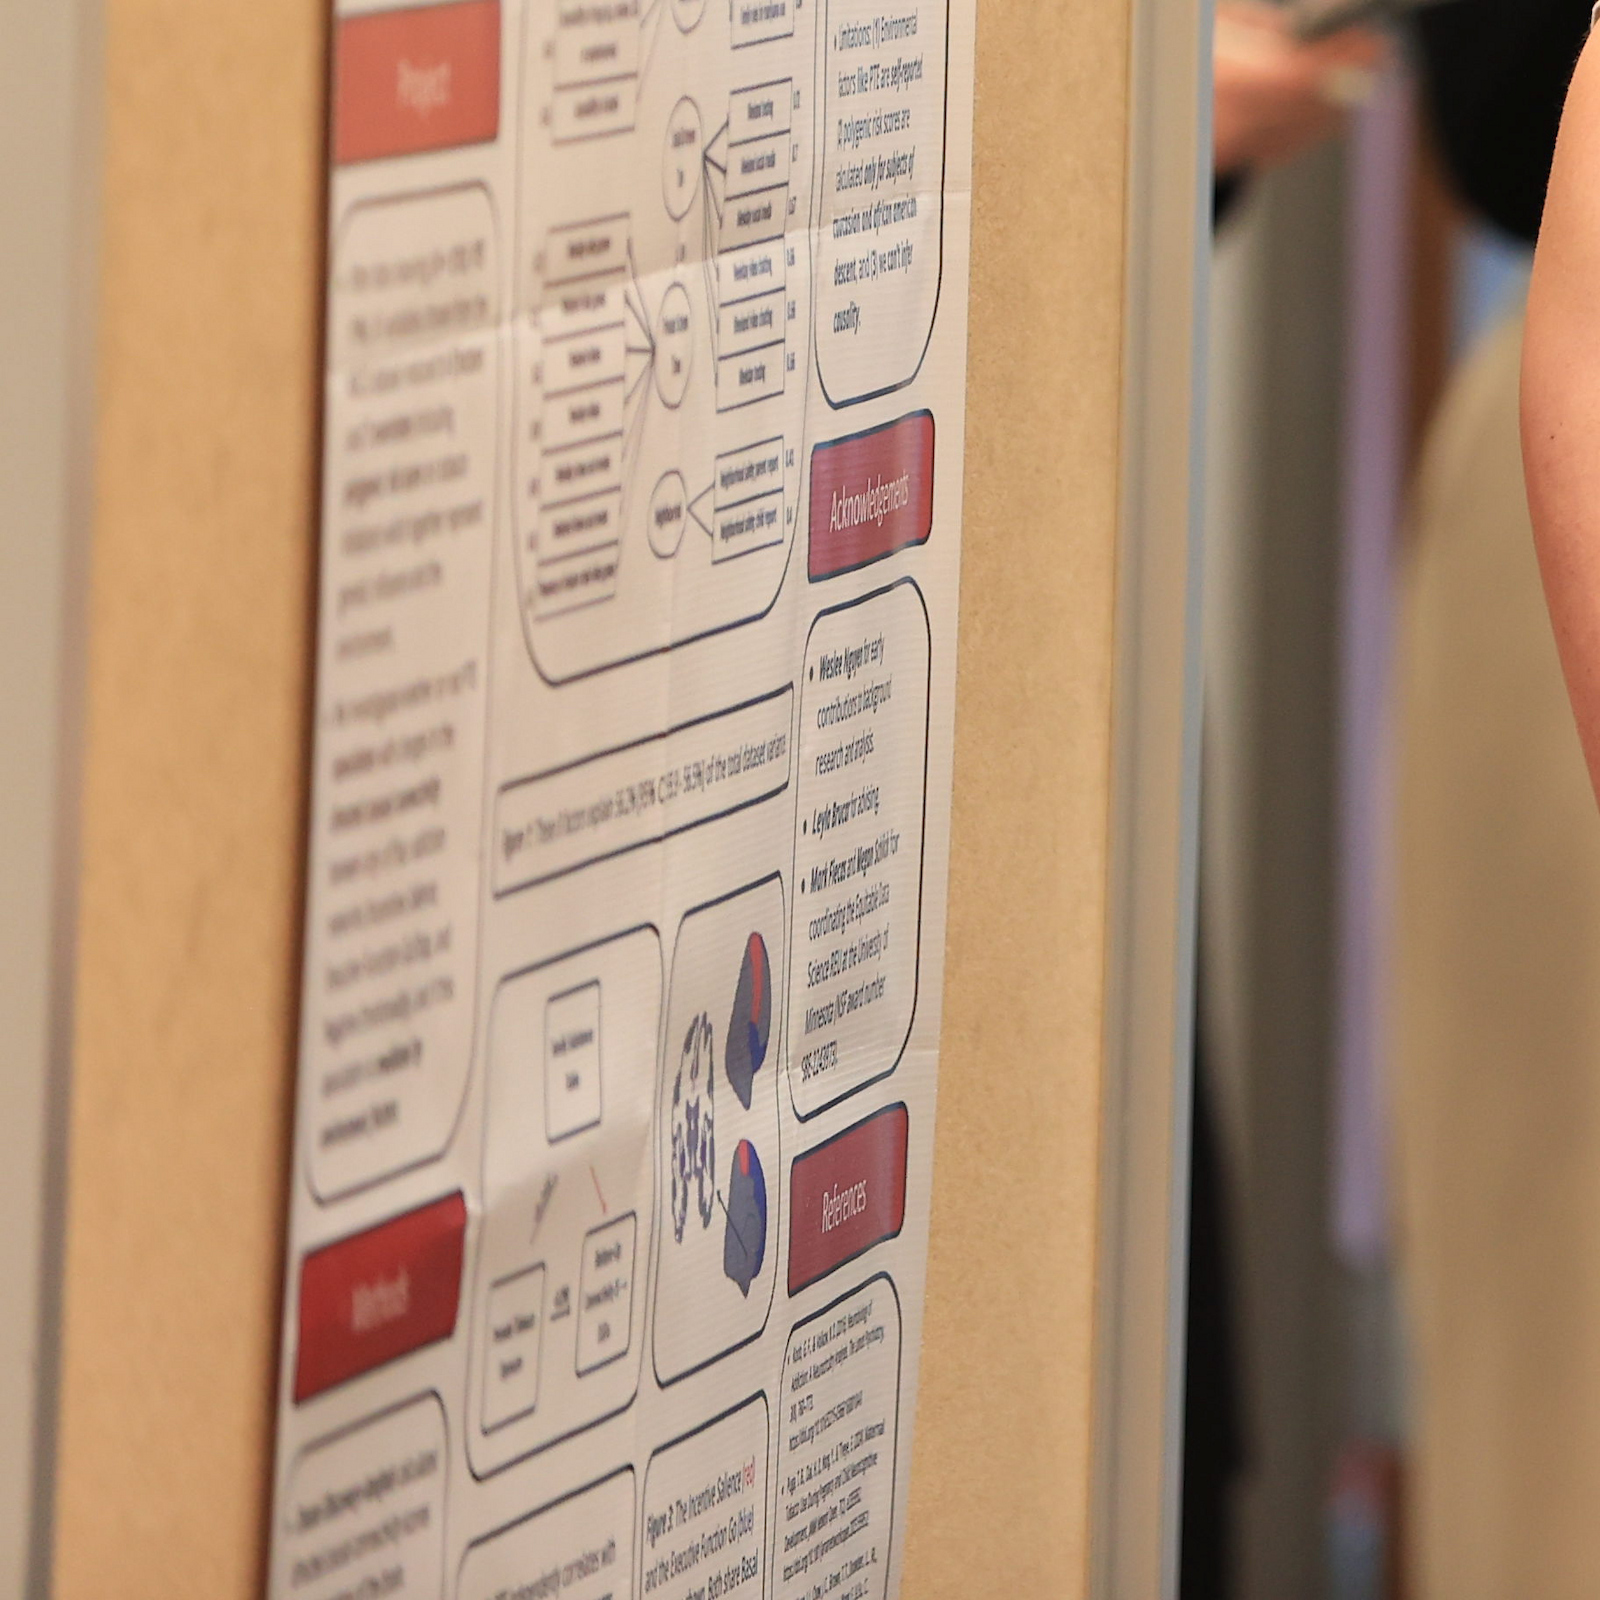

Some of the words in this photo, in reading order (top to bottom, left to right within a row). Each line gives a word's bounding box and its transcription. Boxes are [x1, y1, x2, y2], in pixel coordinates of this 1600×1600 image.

[829, 469, 910, 534] Acknowledgements
[821, 1179, 867, 1233] References
[741, 1547, 759, 1584] Basal
